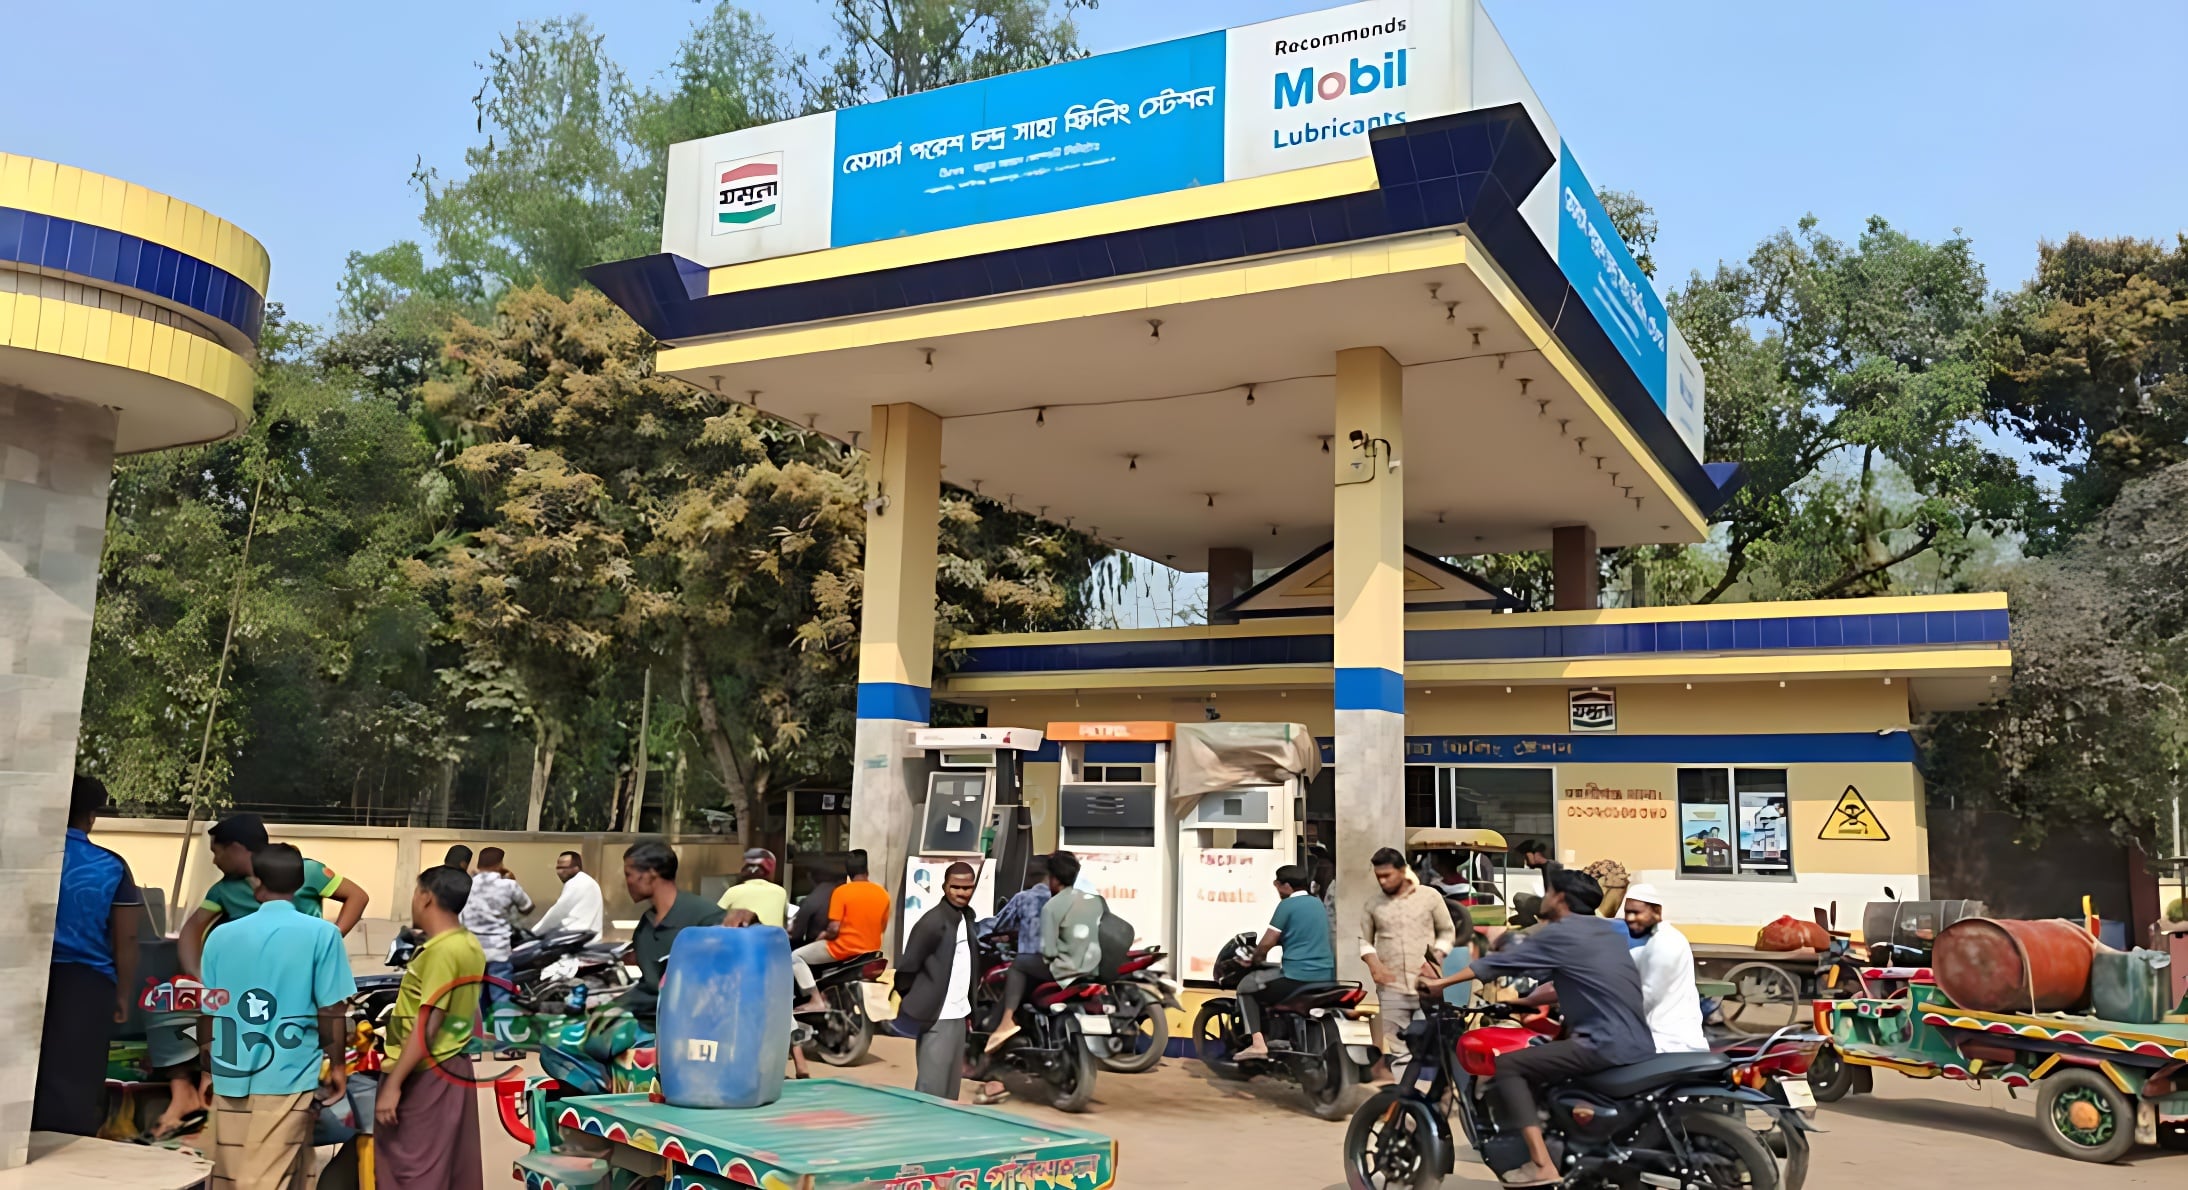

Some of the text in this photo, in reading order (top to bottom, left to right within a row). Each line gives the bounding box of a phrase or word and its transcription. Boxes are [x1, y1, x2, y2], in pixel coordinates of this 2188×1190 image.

[1274, 49, 1406, 109] Mobil
[842, 86, 1215, 174] মেসার্স পরেশ চন্দ্র সাহা ফিলিং স্টেশন
[720, 181, 778, 206] যমুনা
